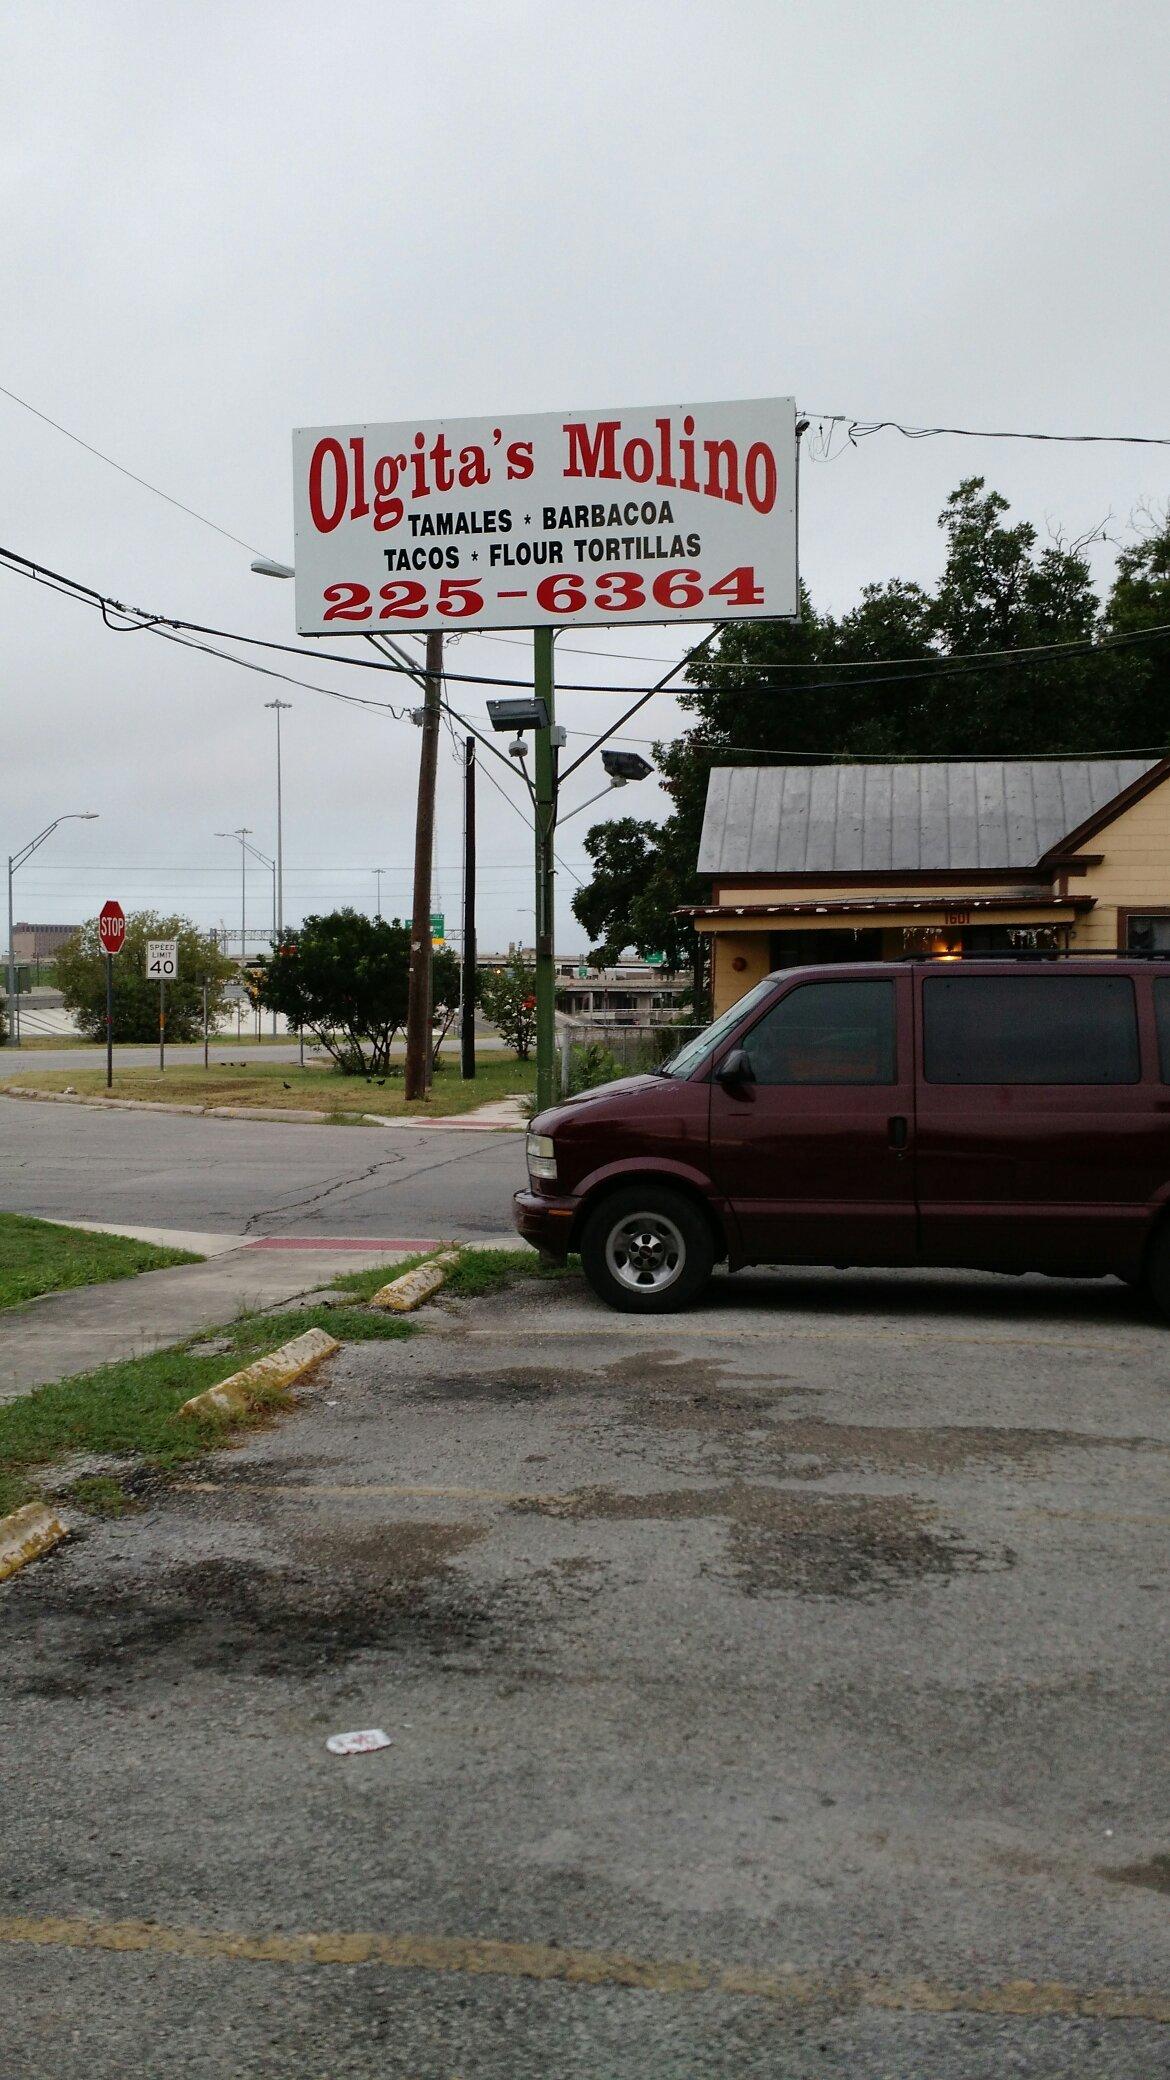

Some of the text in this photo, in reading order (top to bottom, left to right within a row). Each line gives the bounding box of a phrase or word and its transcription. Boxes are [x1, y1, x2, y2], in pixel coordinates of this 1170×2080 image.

[309, 415, 777, 534] Olgita's Molino
[407, 500, 675, 537] TAMALES BARBACOA
[383, 533, 702, 572] TACOS FLOUR TORTILLAS
[323, 566, 765, 621] 225-6364
[101, 917, 124, 936] STOP
[150, 960, 174, 974] 40
